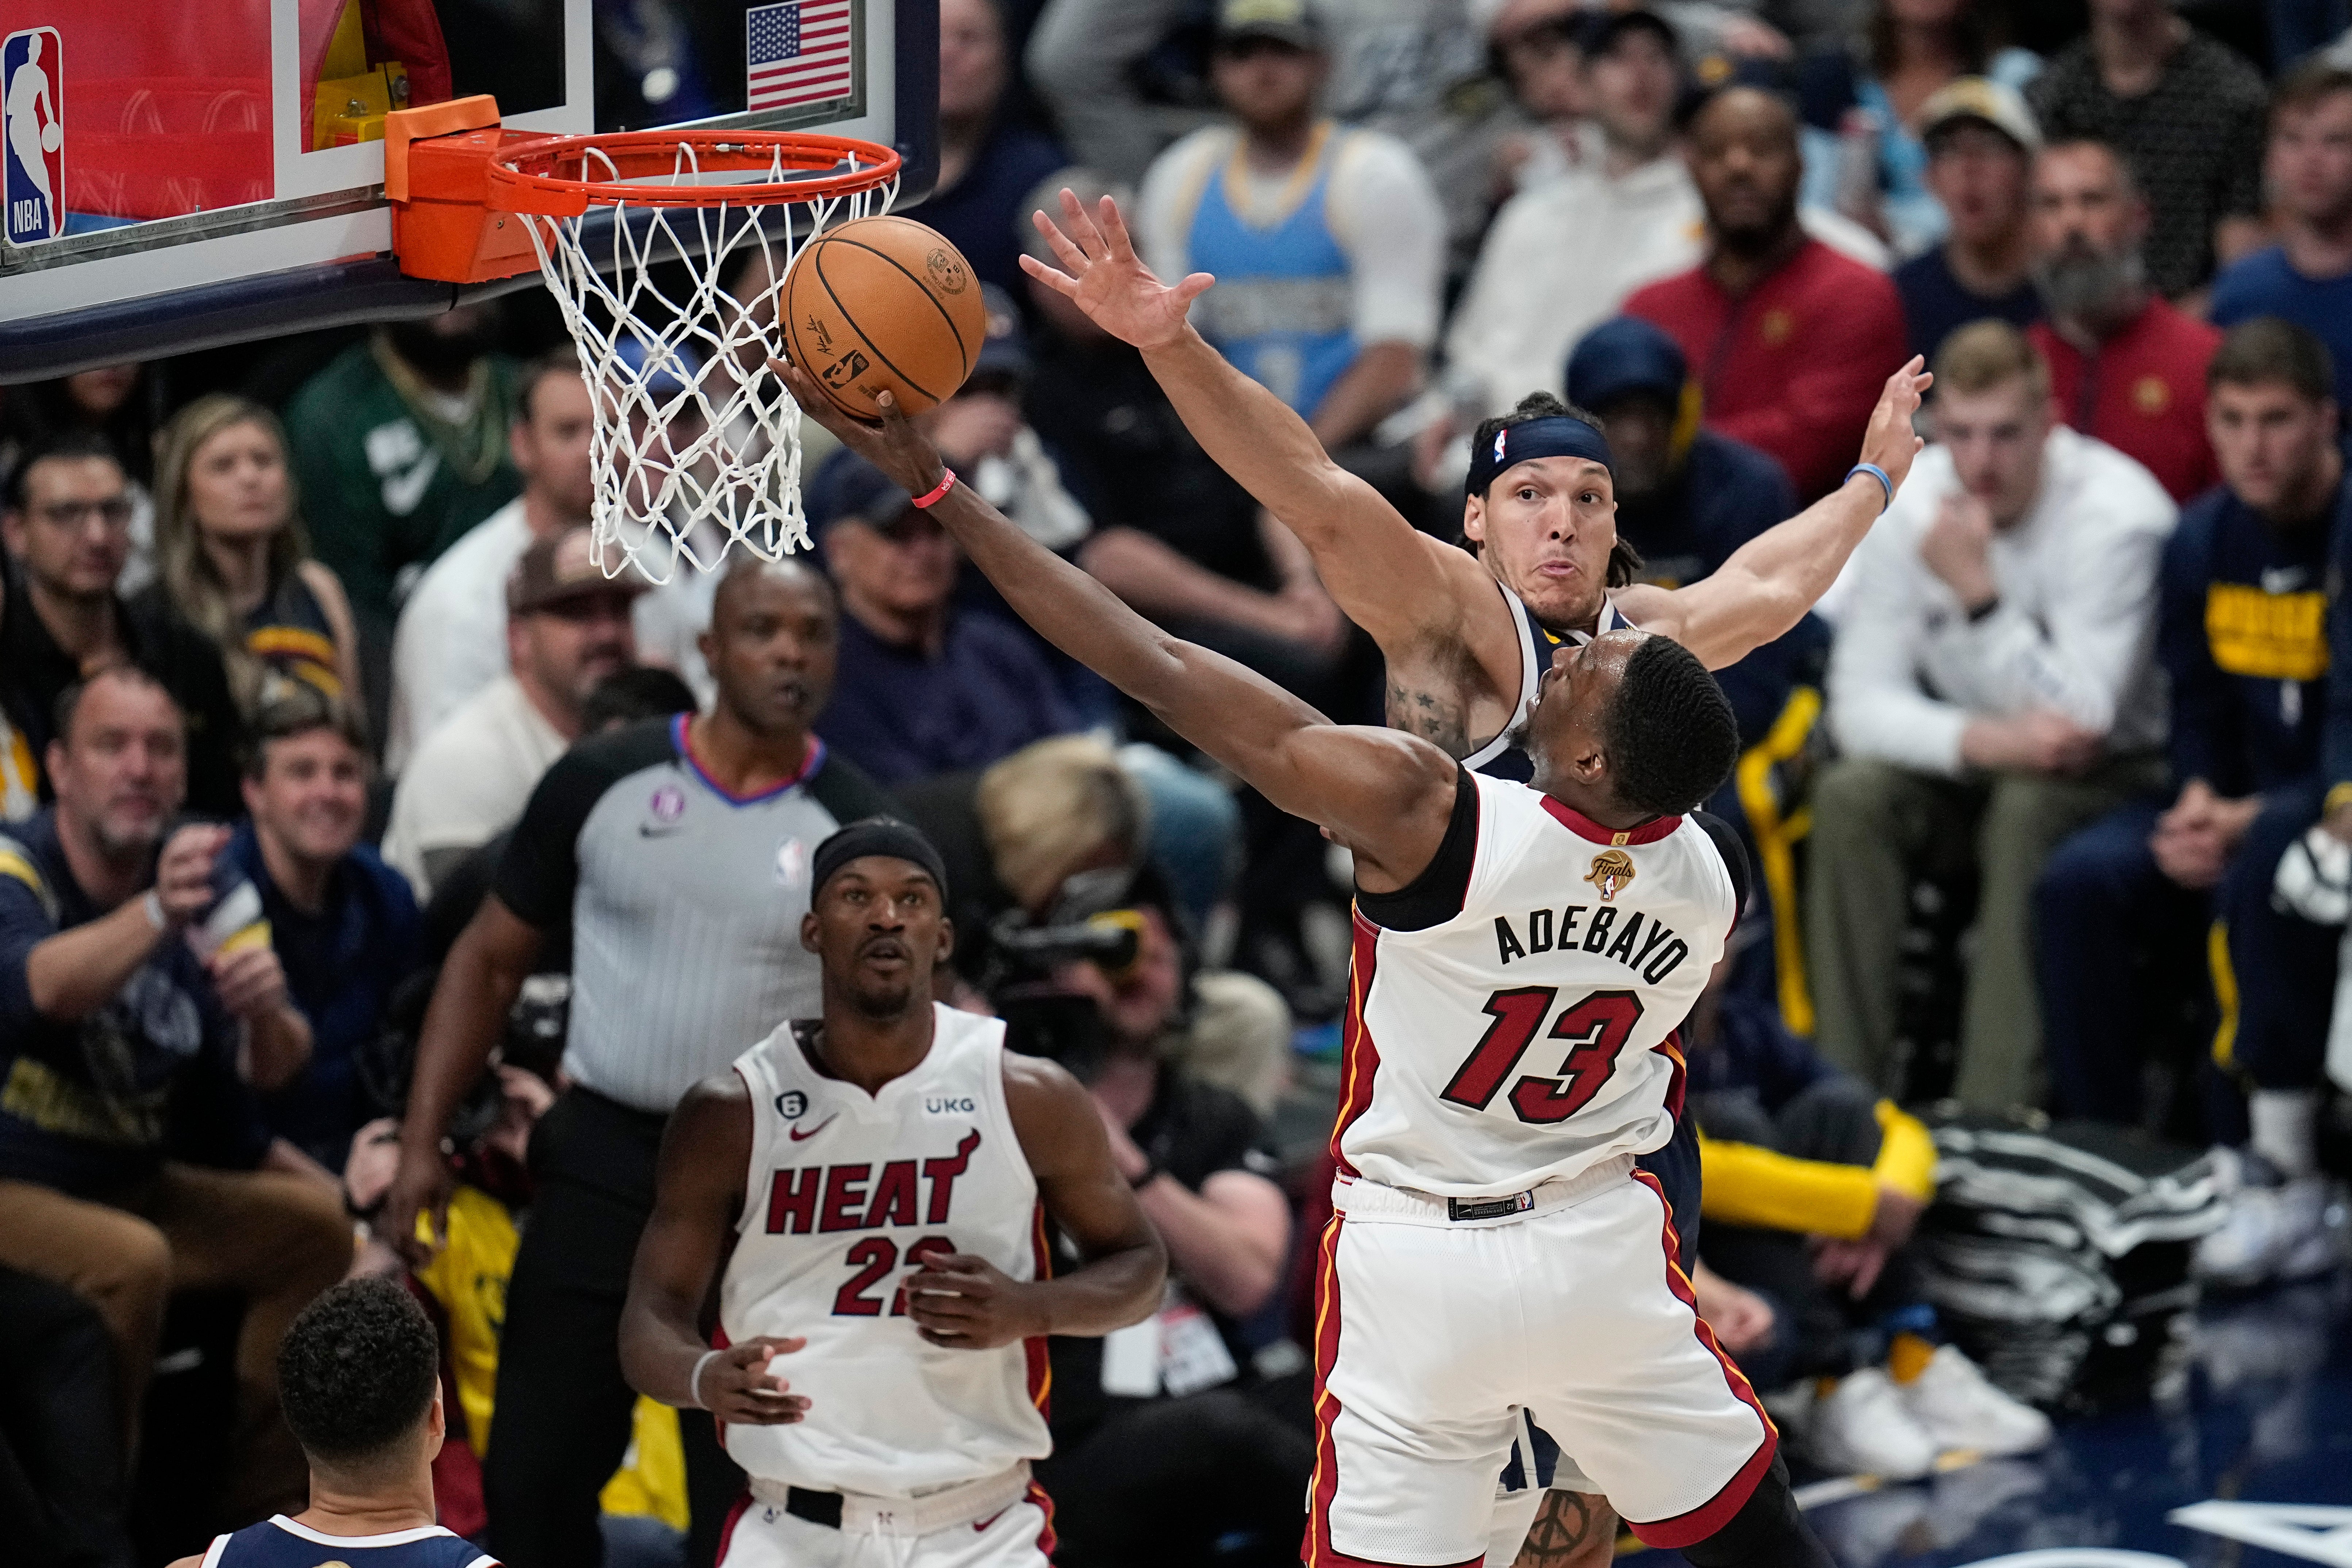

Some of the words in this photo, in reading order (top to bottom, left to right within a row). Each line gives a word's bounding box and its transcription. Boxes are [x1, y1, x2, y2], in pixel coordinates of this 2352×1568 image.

[14, 197, 42, 234] NBA
[1586, 858, 1633, 880] Finals
[1495, 906, 1688, 985] ADEBAYO
[1440, 985, 1645, 1124] 13
[781, 1095, 802, 1116] 6
[925, 1098, 975, 1114] UKG
[765, 1127, 981, 1235] HEAT
